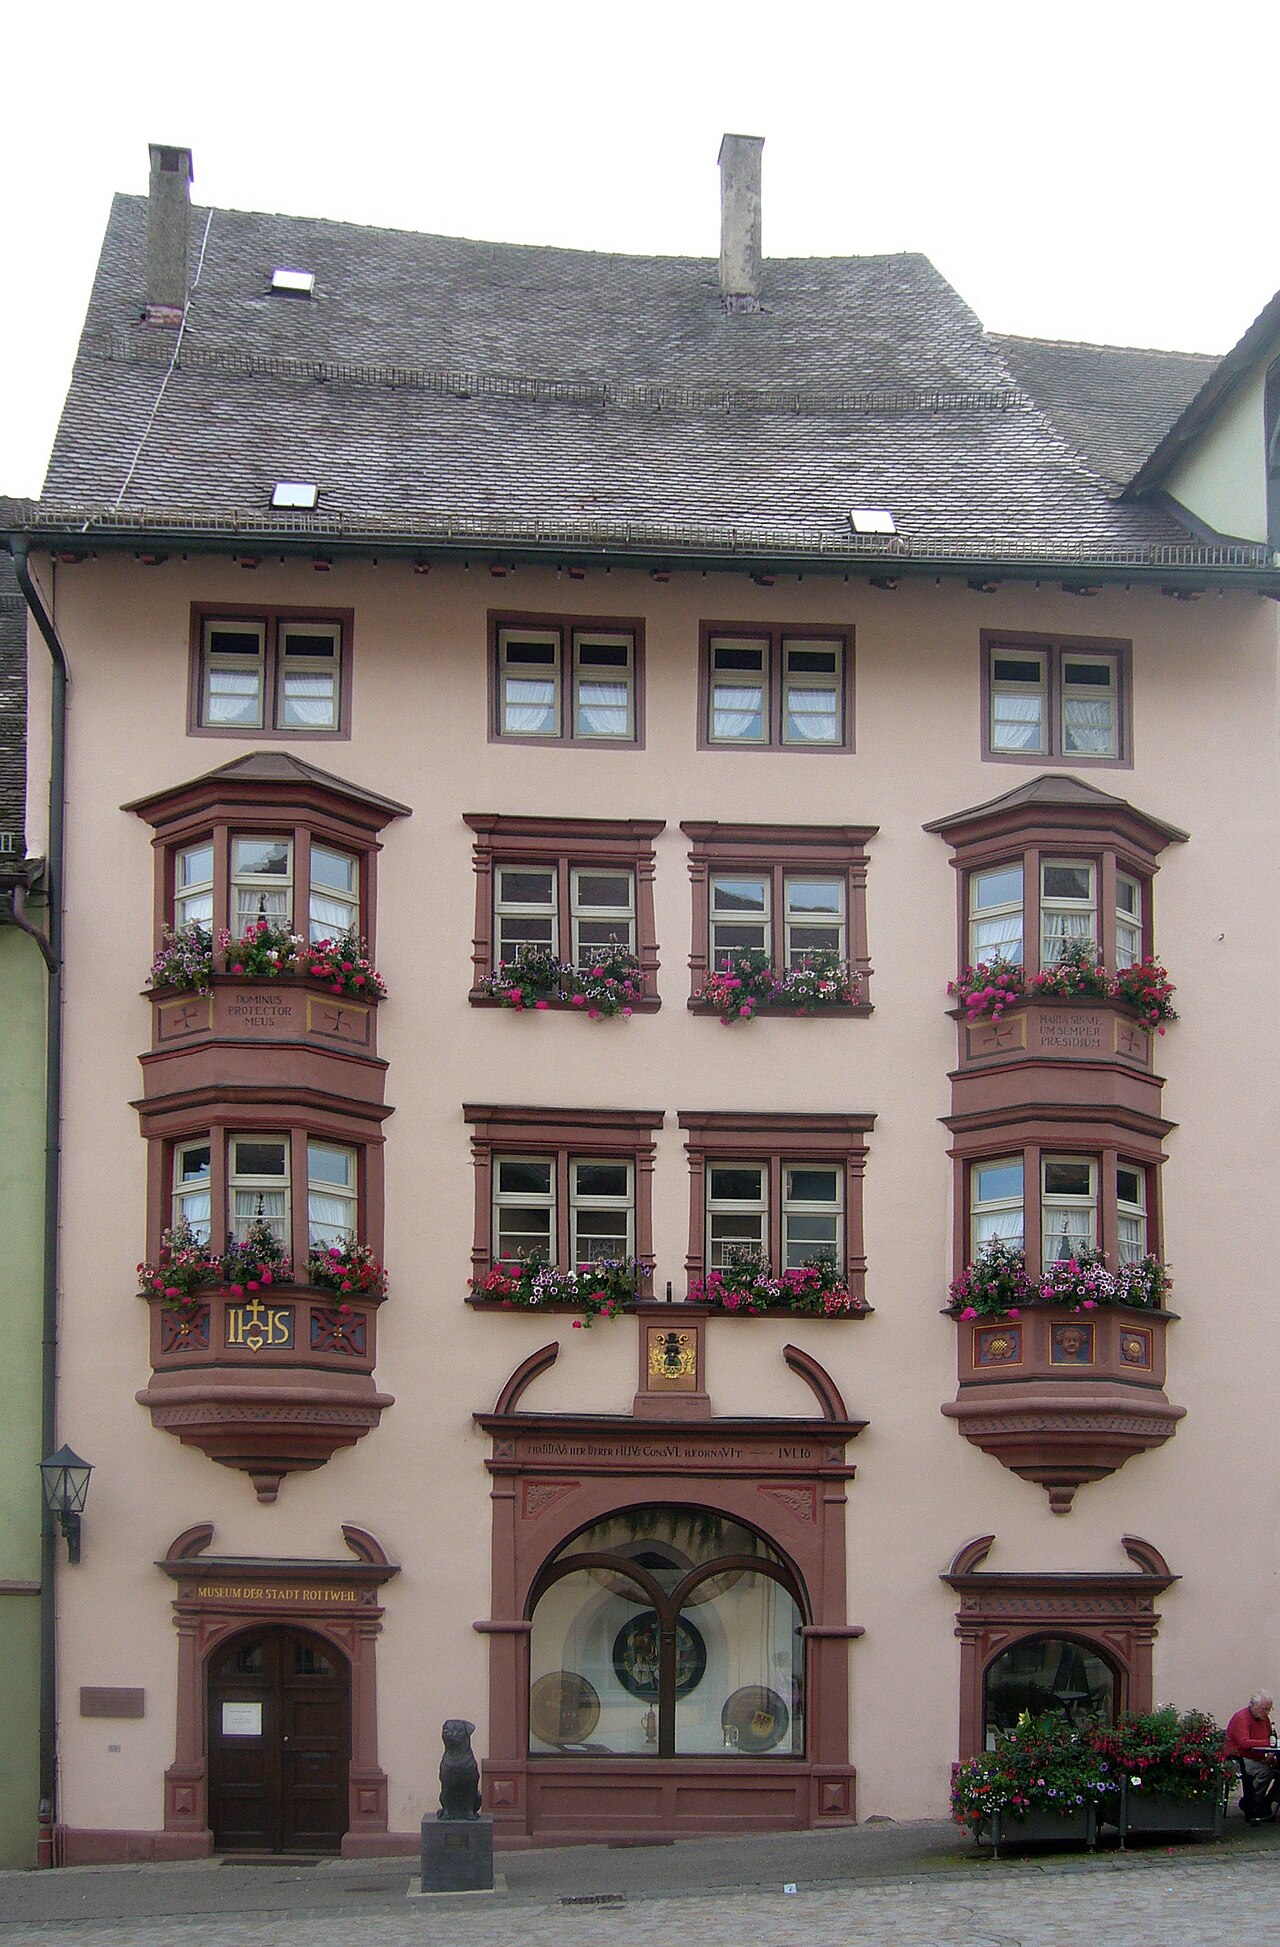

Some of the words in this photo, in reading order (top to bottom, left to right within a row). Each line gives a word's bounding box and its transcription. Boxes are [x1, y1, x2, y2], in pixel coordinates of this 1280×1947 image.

[237, 995, 282, 1004] DOMINUS
[228, 1006, 291, 1016] PROTECTOR
[245, 1017, 275, 1027] MEUS
[1040, 1014, 1069, 1024] MARIA
[198, 1587, 243, 1598] MUSEUM
[244, 1588, 263, 1599] DER
[265, 1589, 300, 1600] STADT
[303, 1590, 357, 1601] ROTTWEIL
